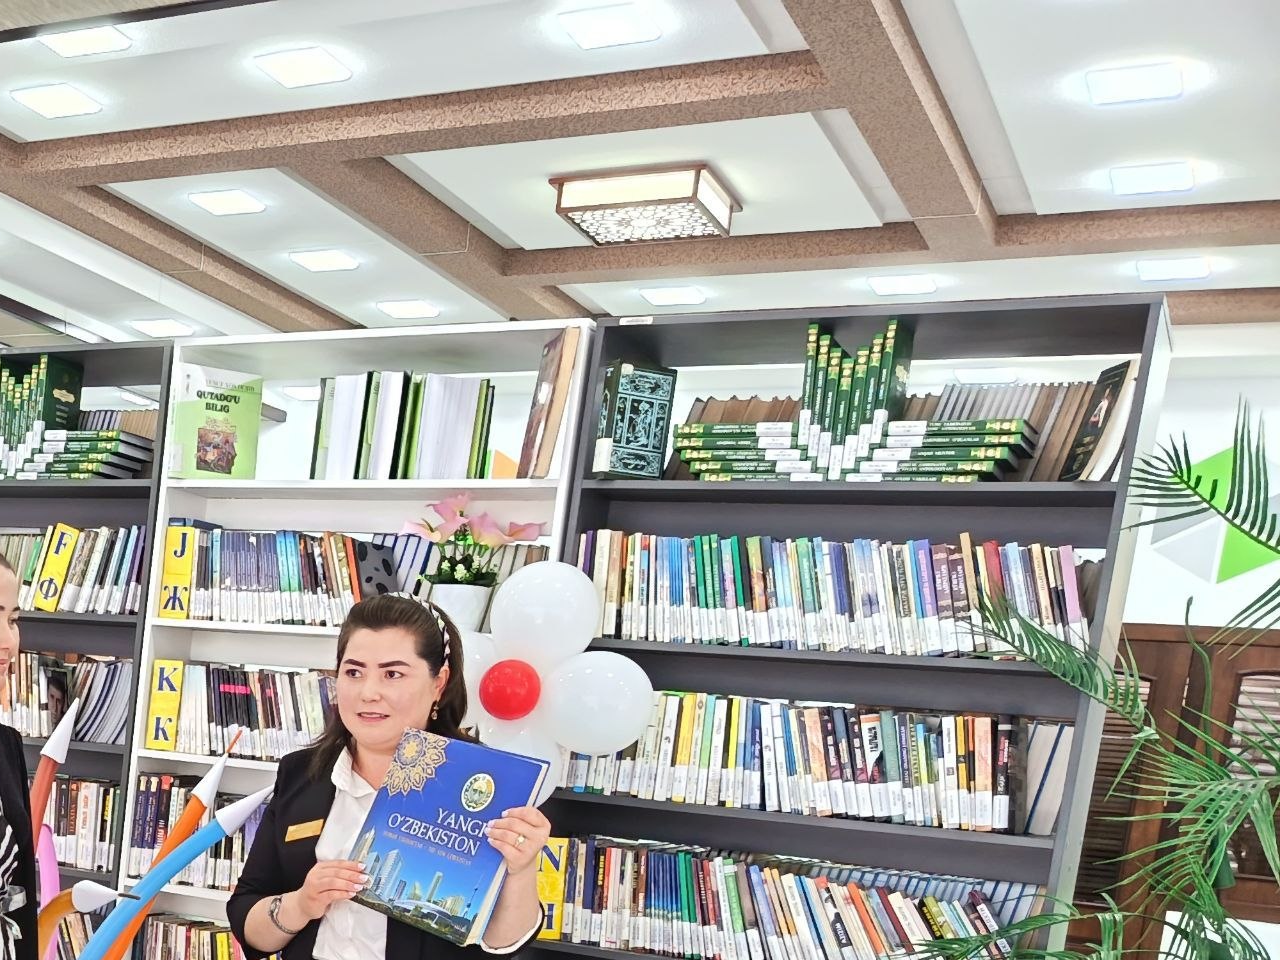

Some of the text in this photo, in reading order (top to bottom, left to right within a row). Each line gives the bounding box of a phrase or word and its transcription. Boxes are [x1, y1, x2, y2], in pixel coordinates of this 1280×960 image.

[53, 531, 73, 555] F
[173, 532, 188, 558] J
[39, 577, 59, 600] Ф
[162, 585, 189, 611] Ж
[157, 666, 179, 692] K
[388, 813, 481, 856] O'ZBEKISTON
[436, 807, 489, 837] YANGI
[537, 844, 564, 872] N
